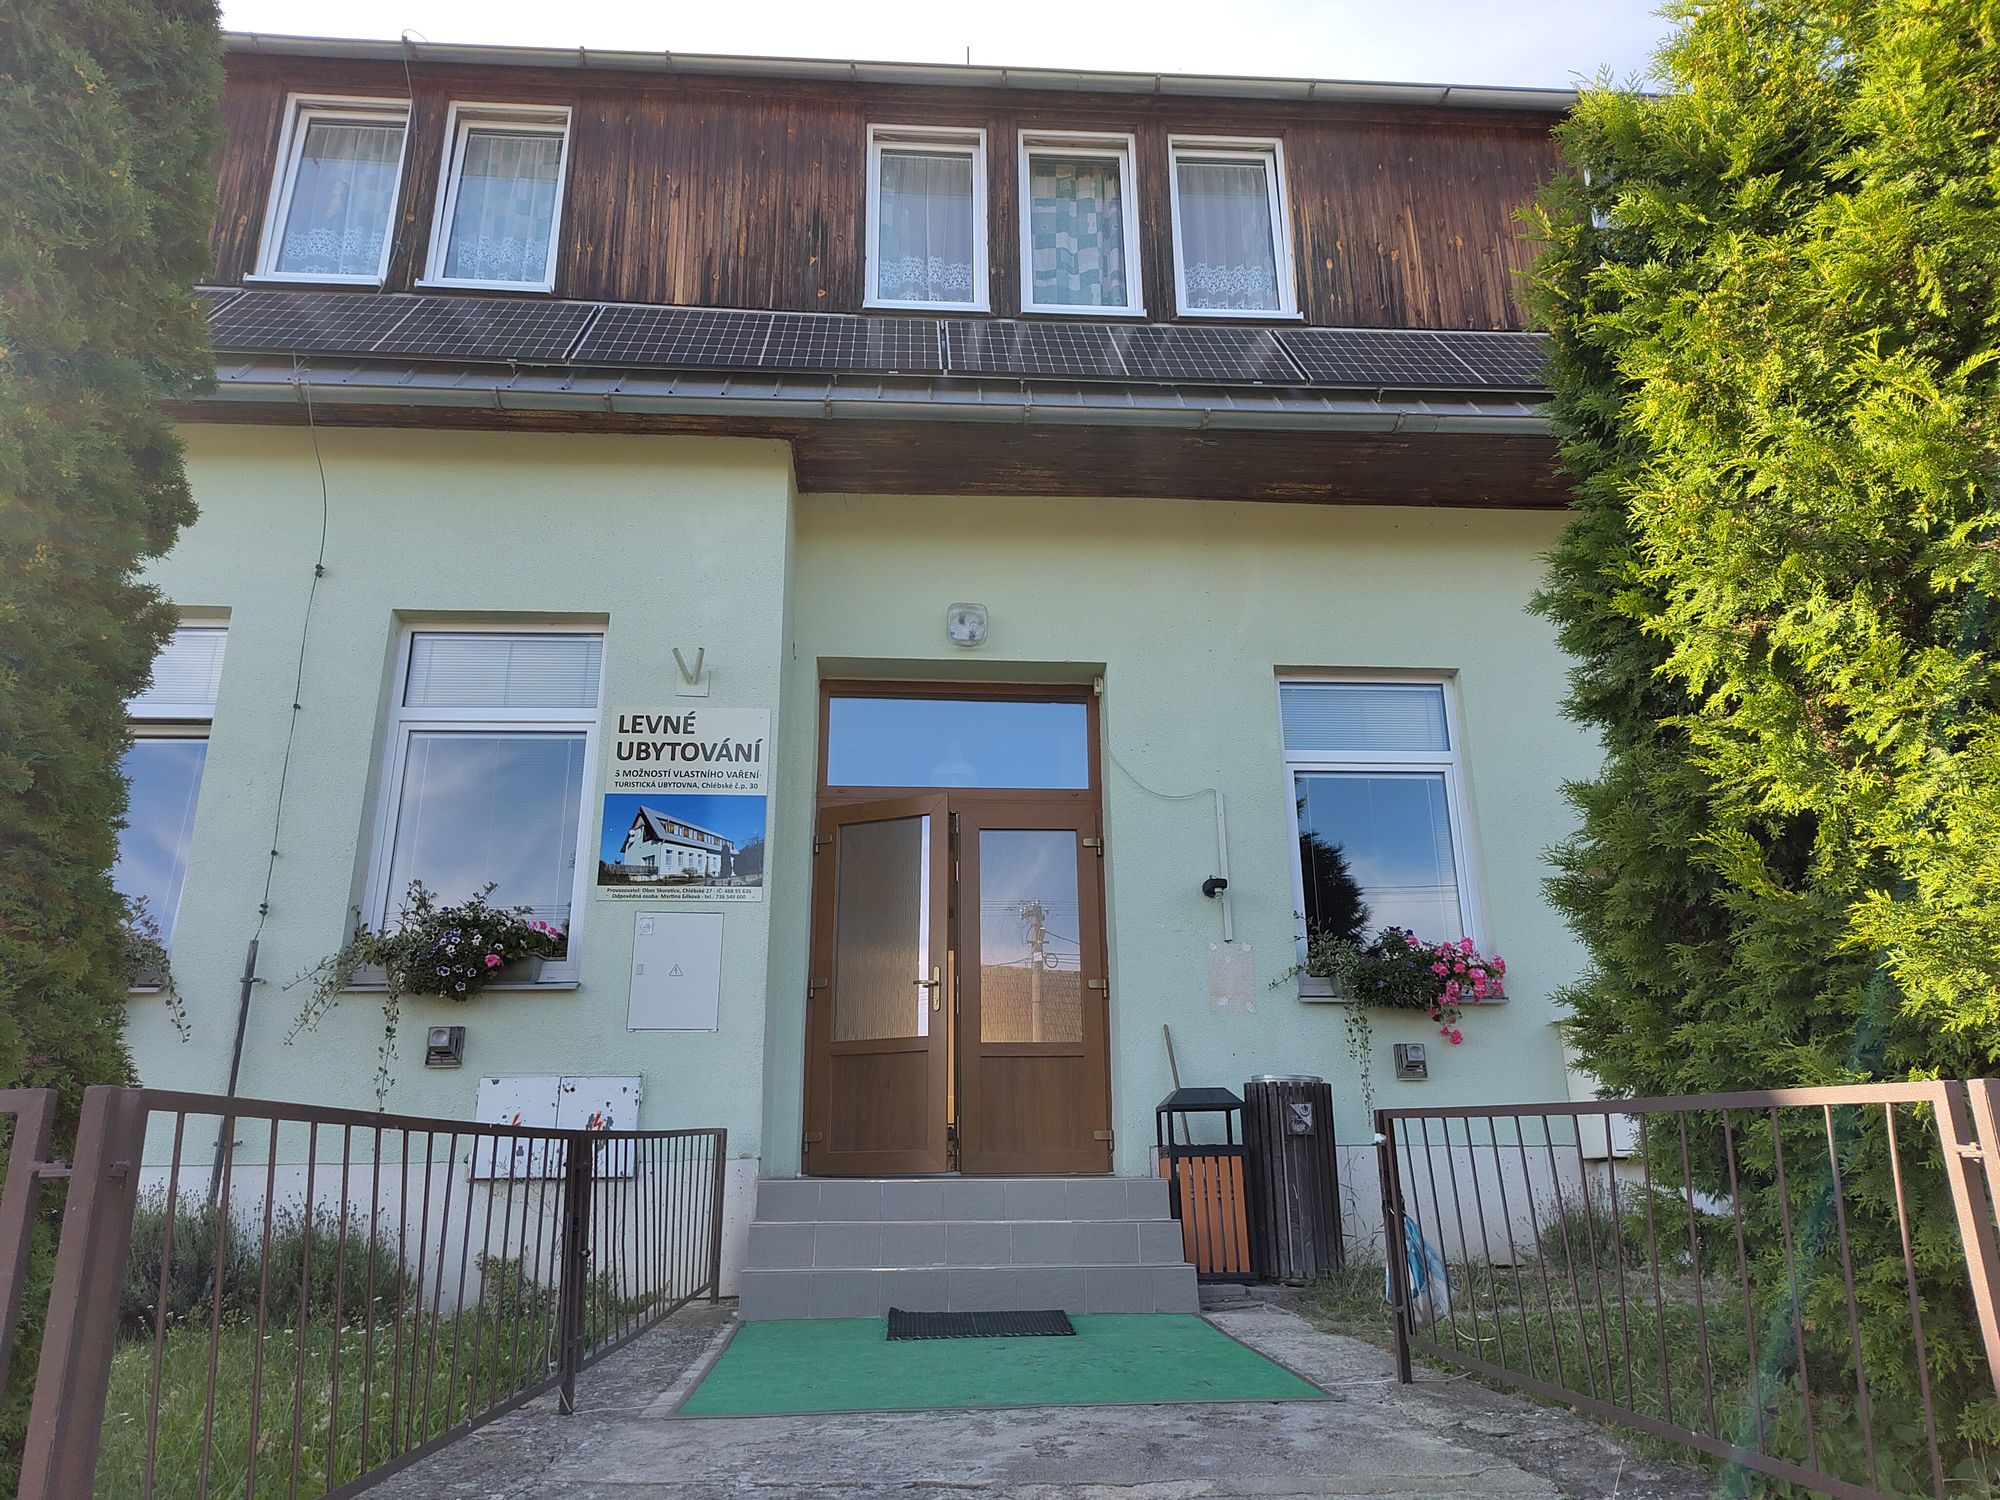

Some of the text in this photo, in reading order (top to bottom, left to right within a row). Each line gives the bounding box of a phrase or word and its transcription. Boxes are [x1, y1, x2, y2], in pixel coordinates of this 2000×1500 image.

[618, 711, 696, 734] LEVNÉ
[616, 738, 763, 762] UBYTOVÁNÍ
[622, 768, 671, 778] MOŽNOSTÍ
[674, 769, 724, 779] VLASTNÍHO
[726, 770, 760, 779] VAŘENÍ
